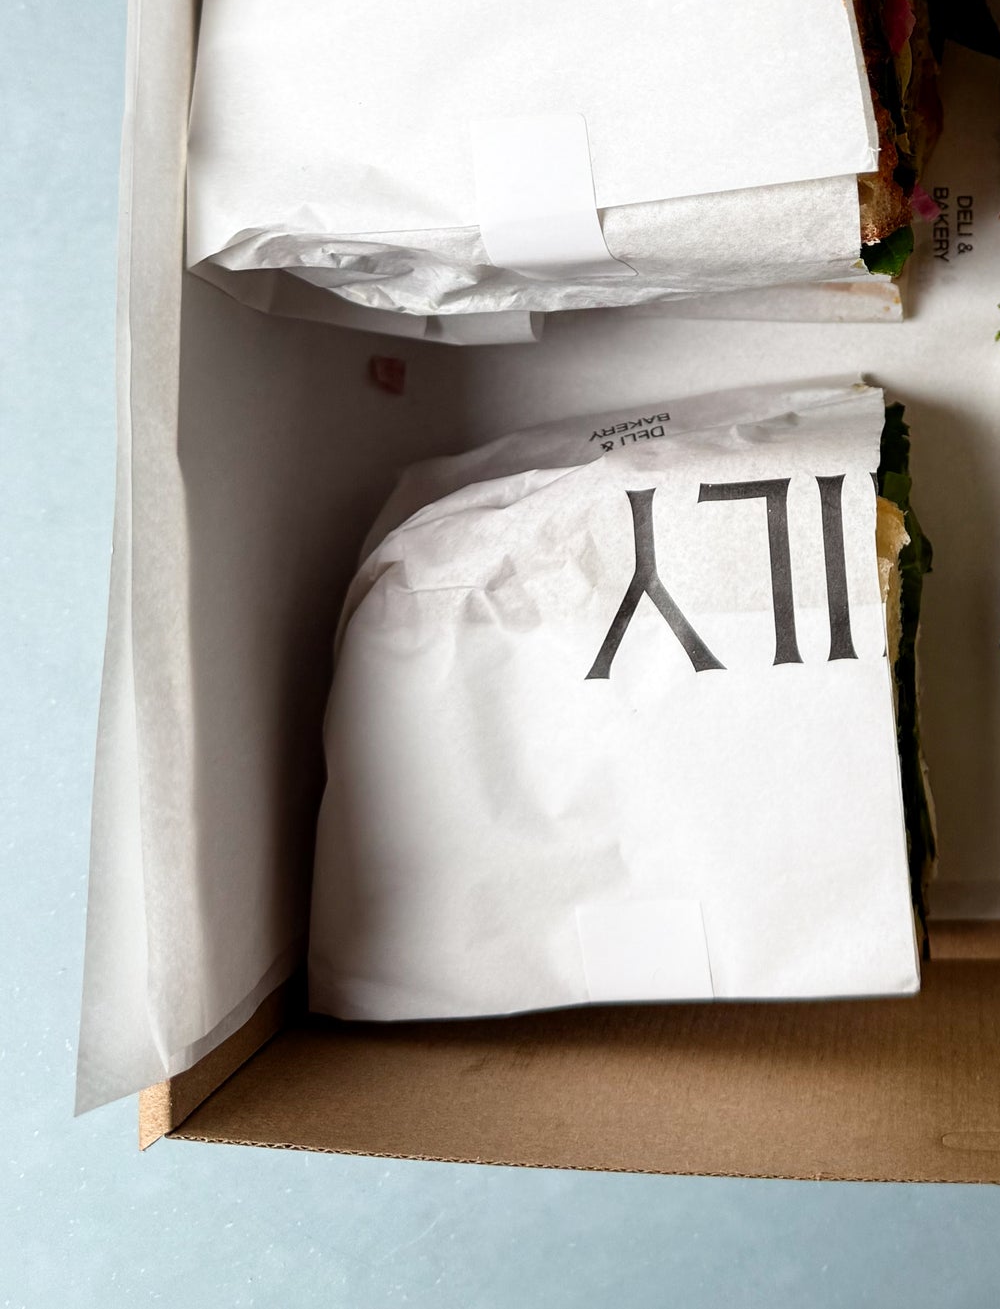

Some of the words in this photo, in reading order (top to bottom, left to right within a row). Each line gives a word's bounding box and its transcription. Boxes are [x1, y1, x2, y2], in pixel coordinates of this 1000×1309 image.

[933, 187, 950, 262] BAKERY
[956, 195, 974, 237] DELI
[957, 243, 974, 255] &
[589, 412, 671, 442] BAKERY
[620, 425, 665, 446] DELI
[600, 440, 614, 452] &
[585, 472, 878, 681] ILY
